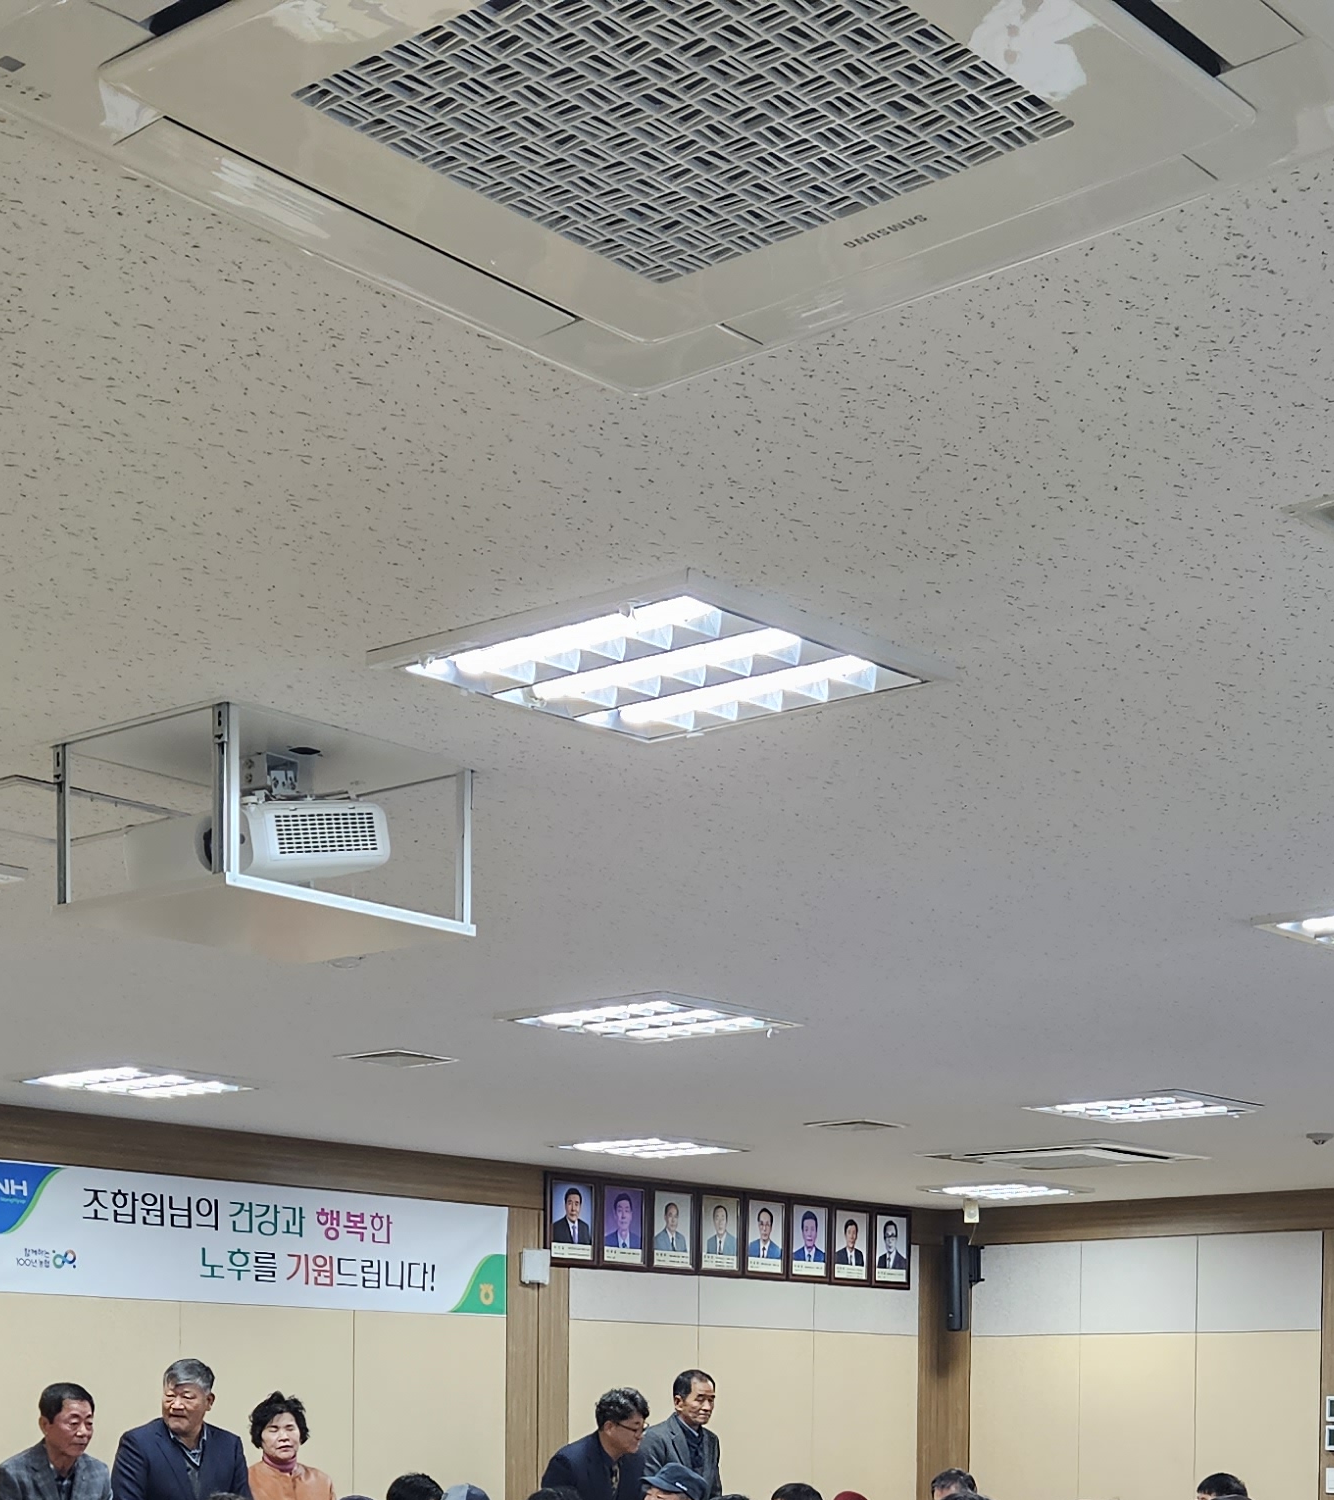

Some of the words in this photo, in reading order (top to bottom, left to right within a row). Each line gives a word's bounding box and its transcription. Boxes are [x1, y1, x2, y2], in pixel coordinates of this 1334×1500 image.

[843, 214, 927, 248] SAMSUNG
[82, 1188, 218, 1231] 조합원님의
[228, 1200, 305, 1238] 건강과
[316, 1207, 393, 1244] 행복한
[200, 1247, 277, 1283] 노후를
[285, 1253, 437, 1292] 기원드립니다!
